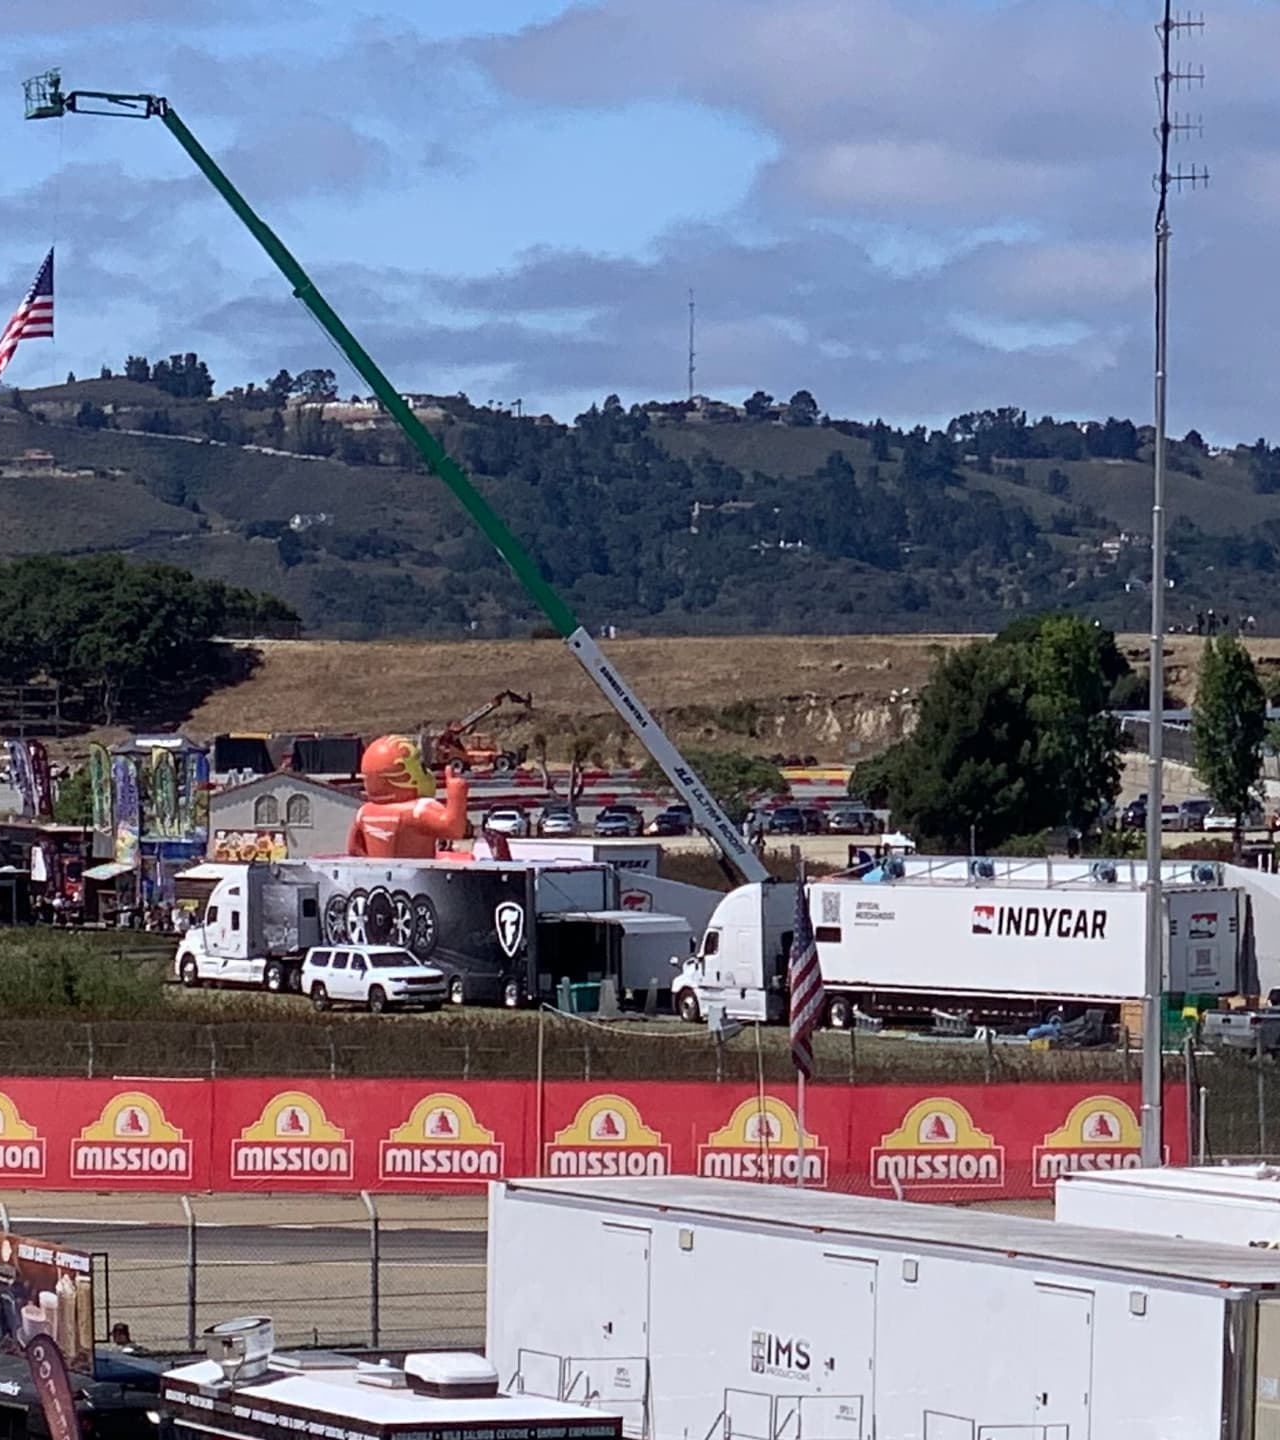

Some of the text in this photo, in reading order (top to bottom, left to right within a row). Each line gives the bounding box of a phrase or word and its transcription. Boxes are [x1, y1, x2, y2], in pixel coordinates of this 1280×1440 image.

[997, 906, 1107, 939] INDYCAR
[767, 1334, 810, 1370] IMS
[463, 1429, 494, 1440] SALMON
